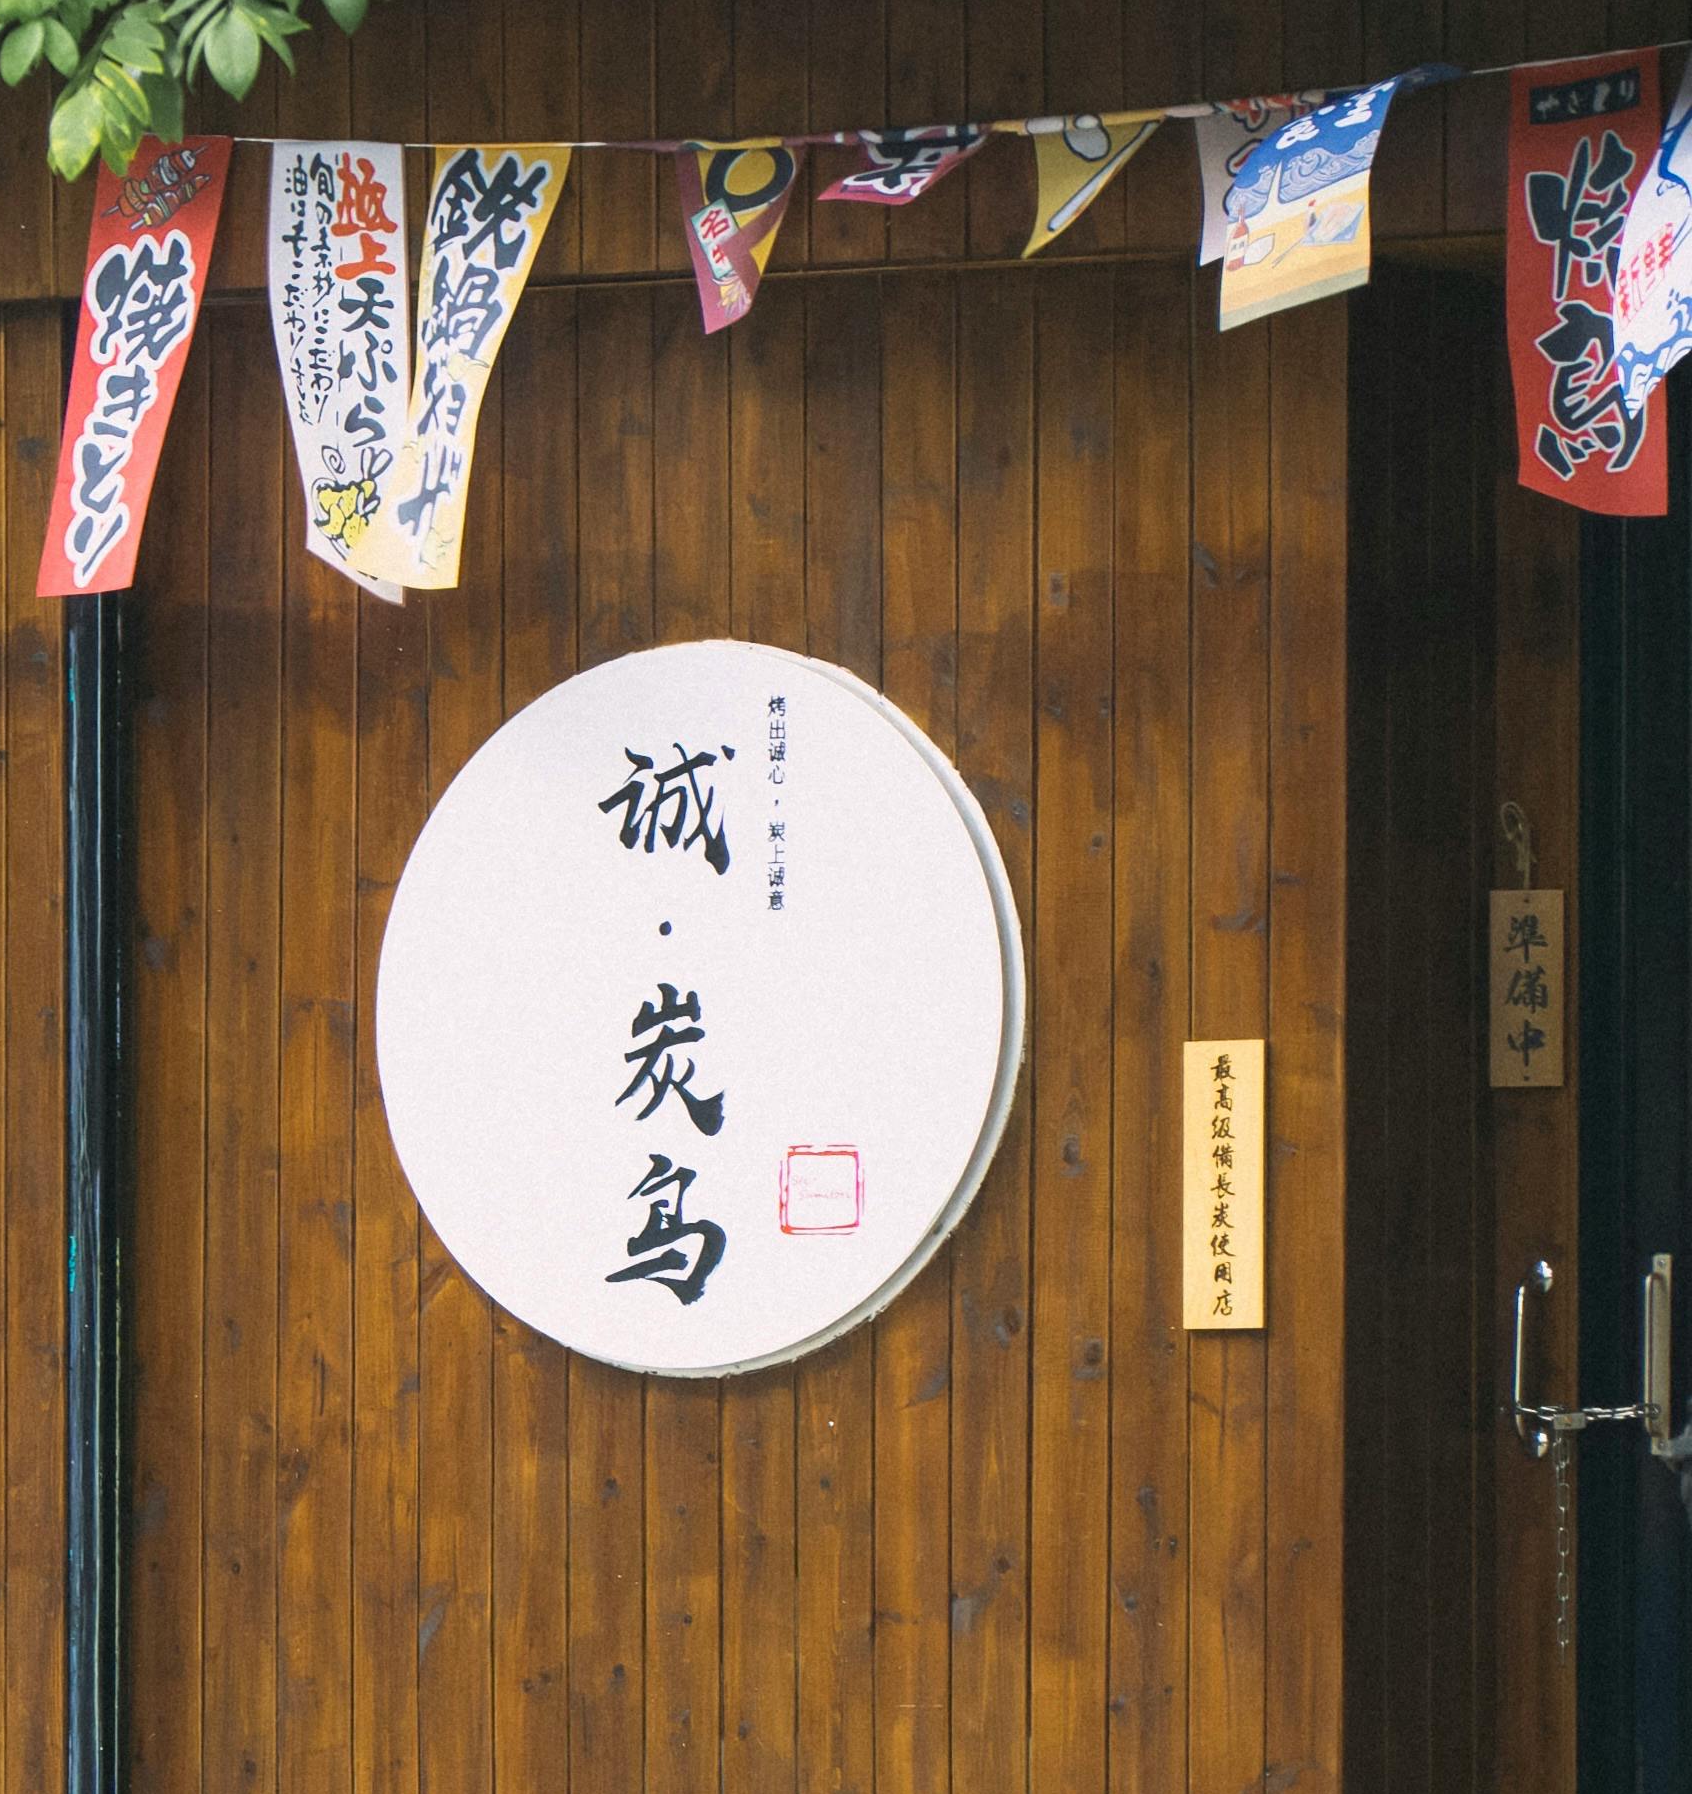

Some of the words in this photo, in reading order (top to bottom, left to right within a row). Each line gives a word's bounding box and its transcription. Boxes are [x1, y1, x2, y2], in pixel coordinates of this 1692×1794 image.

[74, 237, 191, 577] 焼きとり
[332, 151, 398, 444] 極上天ぷら
[1502, 914, 1550, 1066] 準備中
[1210, 1054, 1236, 1317] 最高級備長炭使用店
